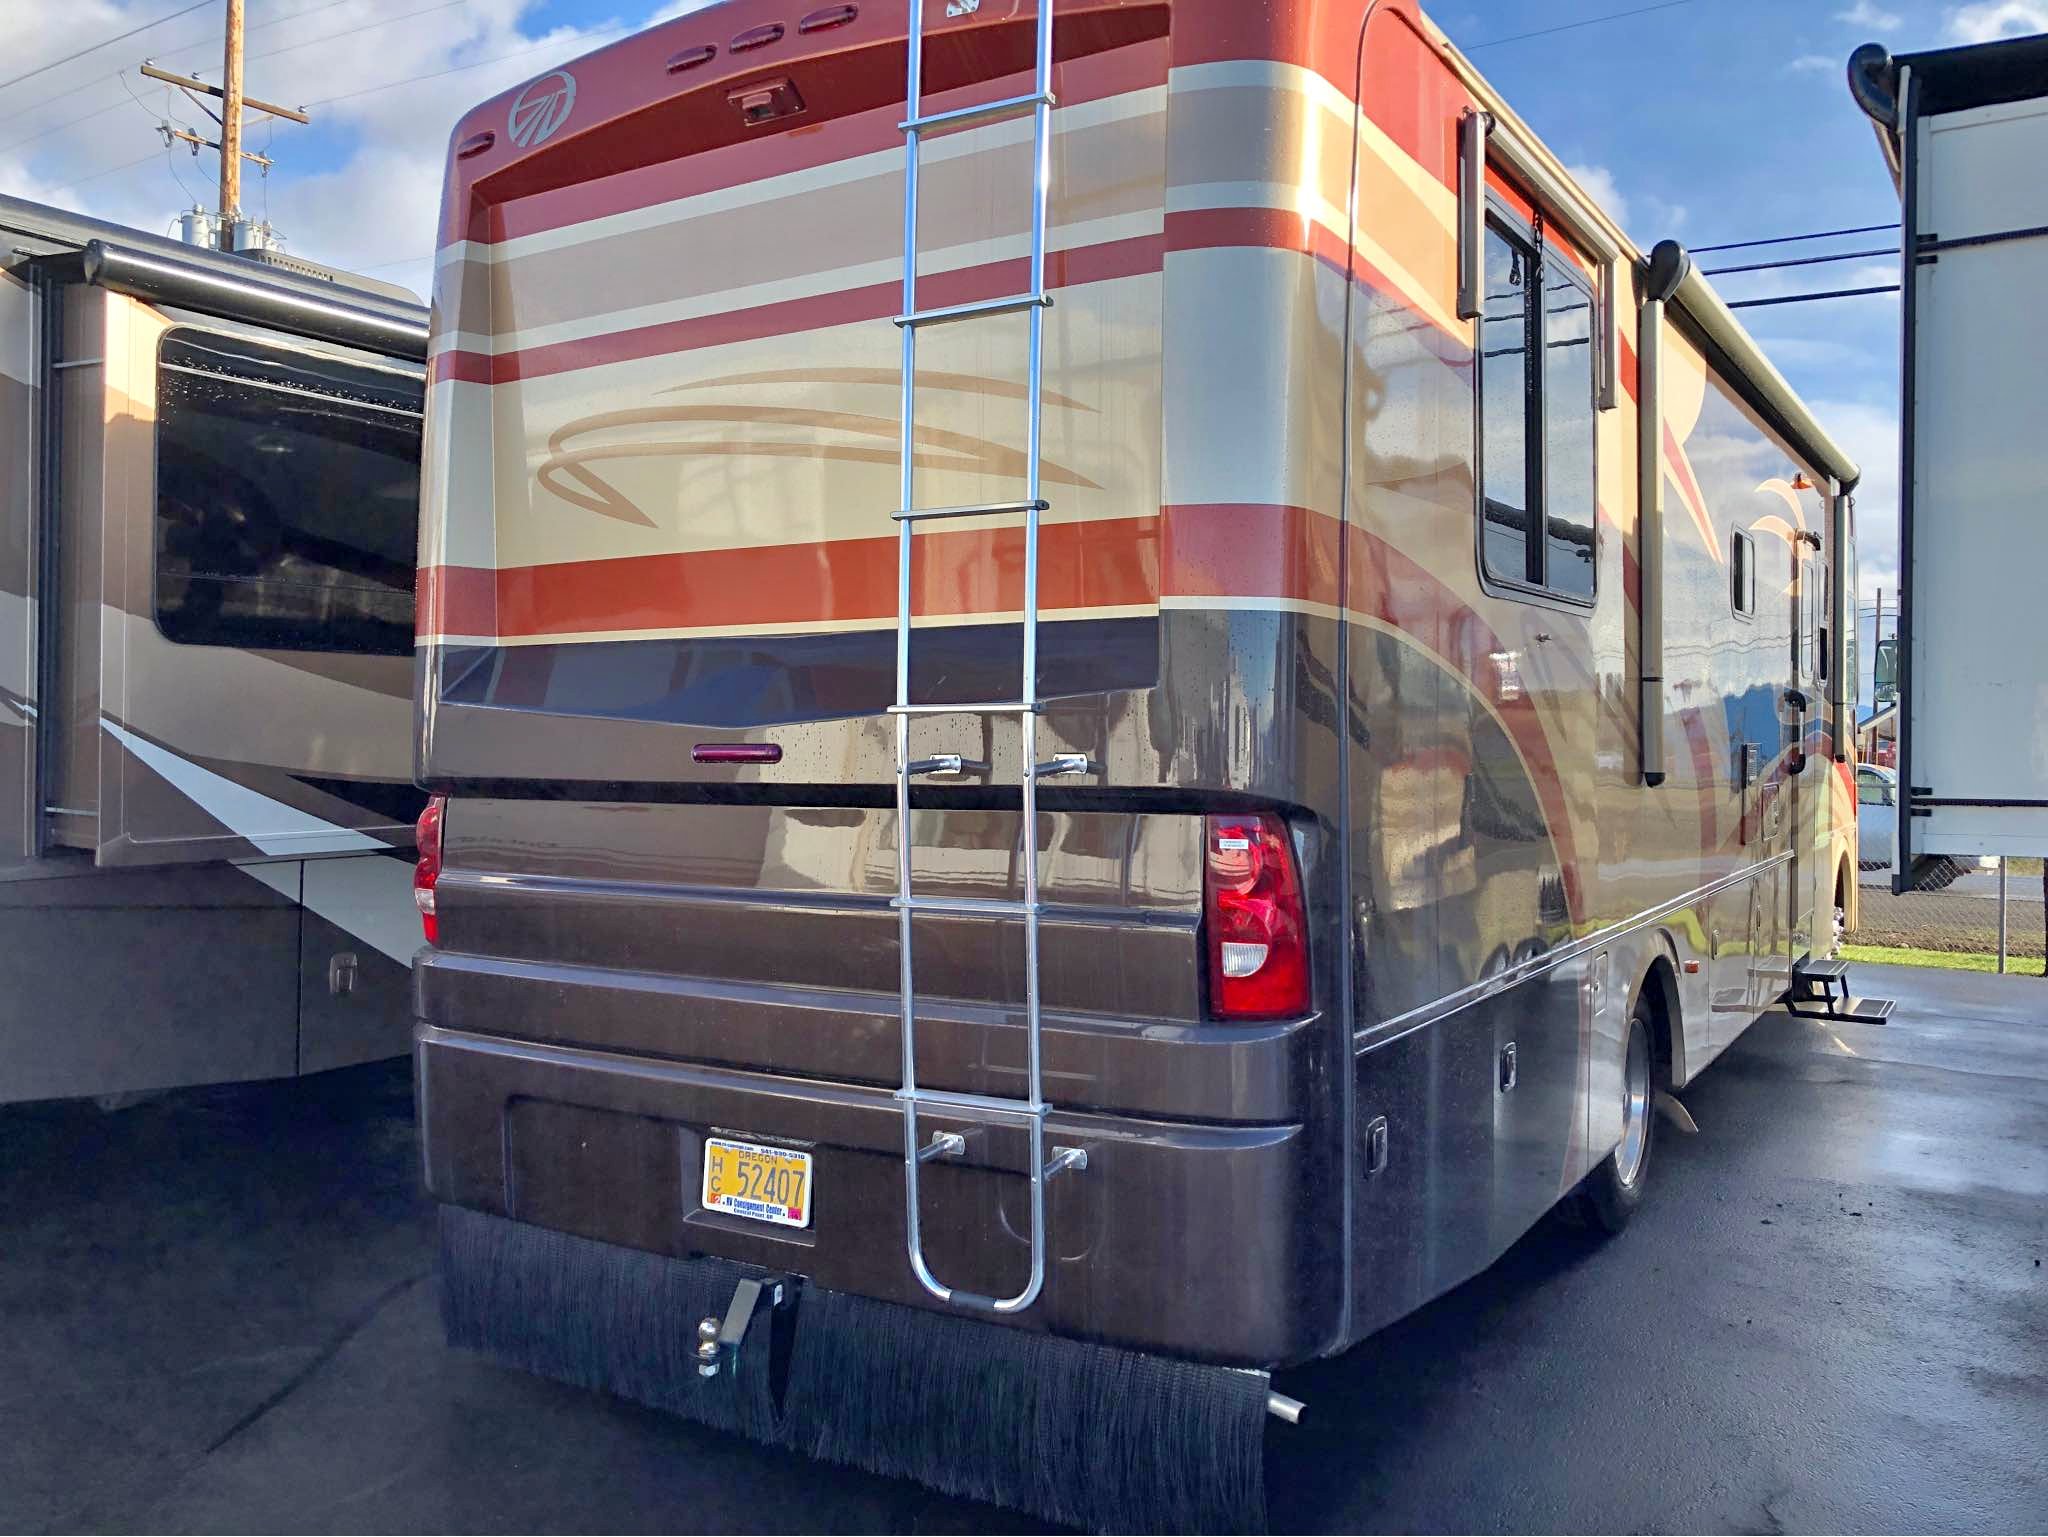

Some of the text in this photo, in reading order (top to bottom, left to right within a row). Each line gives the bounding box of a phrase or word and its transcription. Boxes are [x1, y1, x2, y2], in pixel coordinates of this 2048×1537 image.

[738, 1150, 778, 1164] OREGON
[738, 1161, 805, 1208] 52407
[766, 1204, 782, 1216] Center
